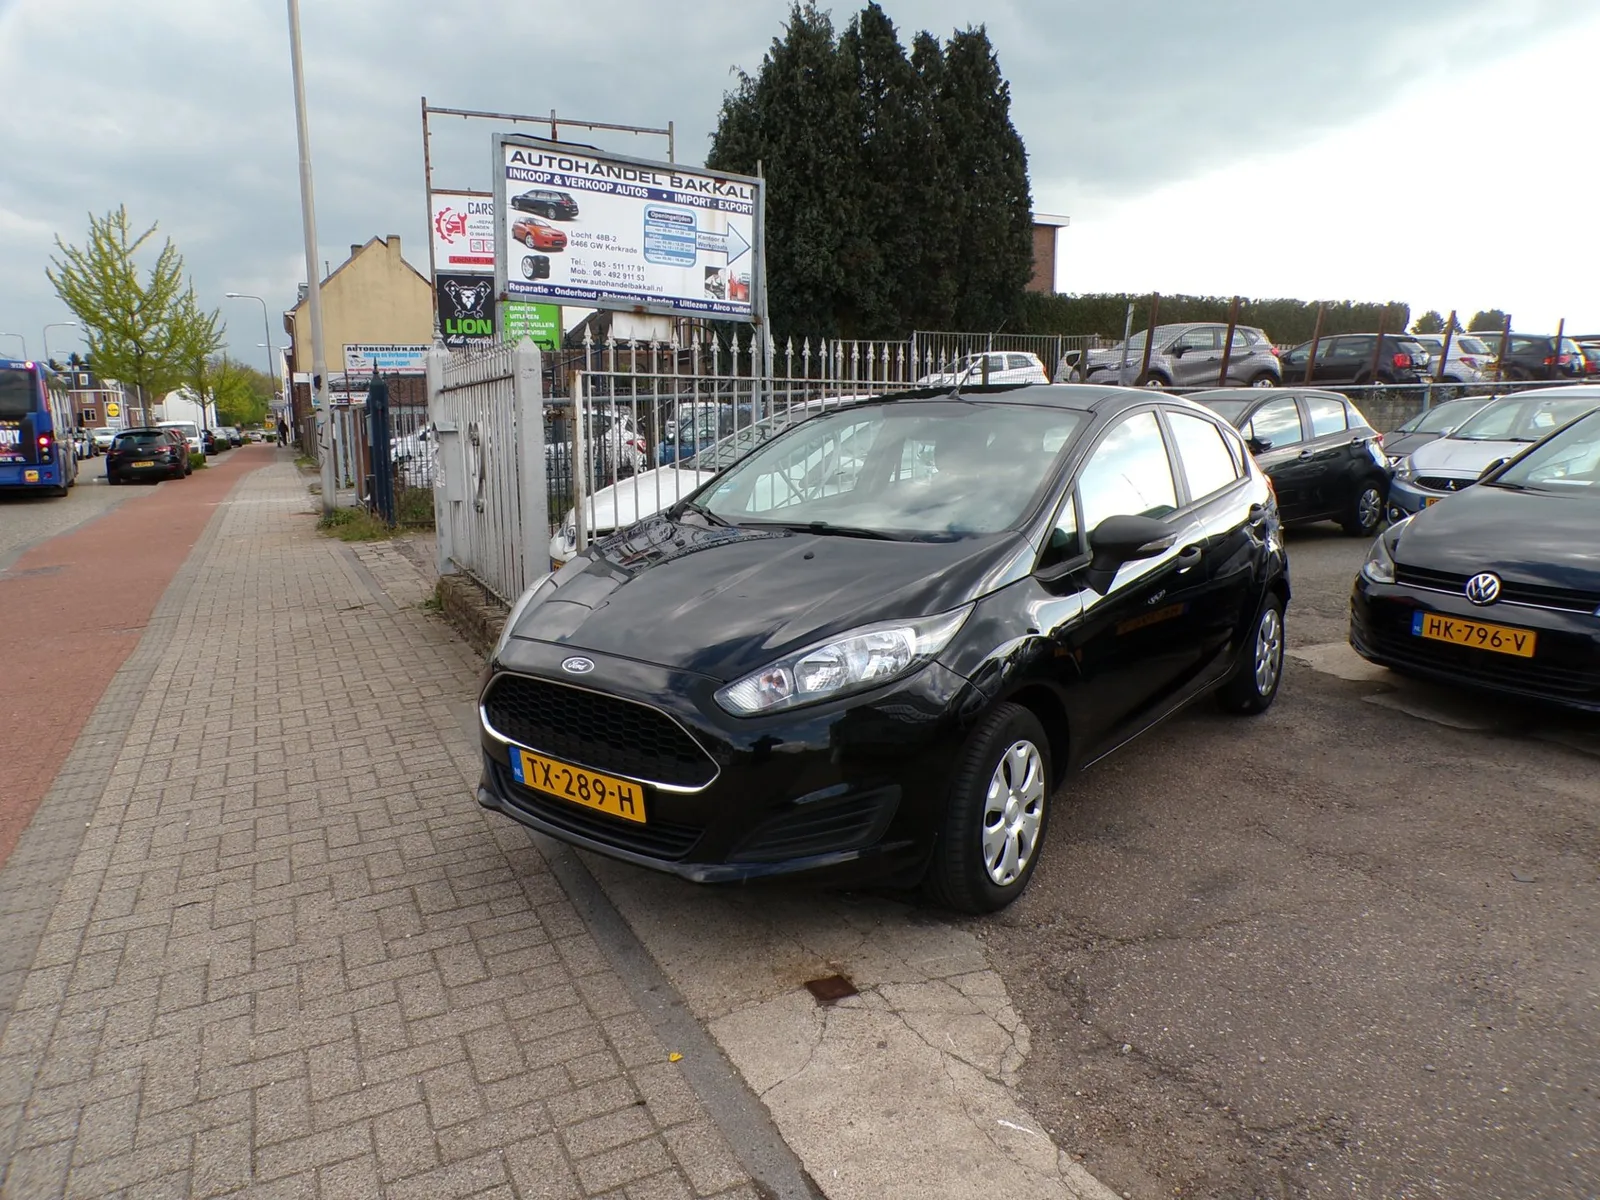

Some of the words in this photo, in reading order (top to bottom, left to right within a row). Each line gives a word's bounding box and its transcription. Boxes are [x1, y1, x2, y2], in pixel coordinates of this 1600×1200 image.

[511, 150, 663, 186] AUTOHANDEL
[509, 169, 551, 183] INKOOP
[554, 175, 563, 185] &
[564, 176, 614, 192] VERKOOP
[616, 185, 649, 198] AUTOS
[674, 193, 711, 207] IMPORT
[718, 200, 753, 214] EXPORT
[570, 230, 592, 240] Locht
[596, 234, 617, 243] 48B-2
[570, 240, 588, 249] 6466
[590, 242, 604, 250] GW
[605, 245, 638, 254] Kerkrade
[593, 260, 606, 269] 045
[613, 262, 625, 270] 511
[570, 277, 663, 292] www.autohandelbakkali.nl
[608, 271, 621, 279] 492
[623, 273, 635, 281] 911
[509, 282, 549, 294] Reparatie
[555, 287, 597, 299] Onderhoud
[679, 299, 707, 309] Uitlezen
[713, 303, 731, 311] Airco
[446, 318, 492, 335] LION
[1429, 618, 1527, 652] HK-796-V
[526, 756, 635, 815] TX-289-H
